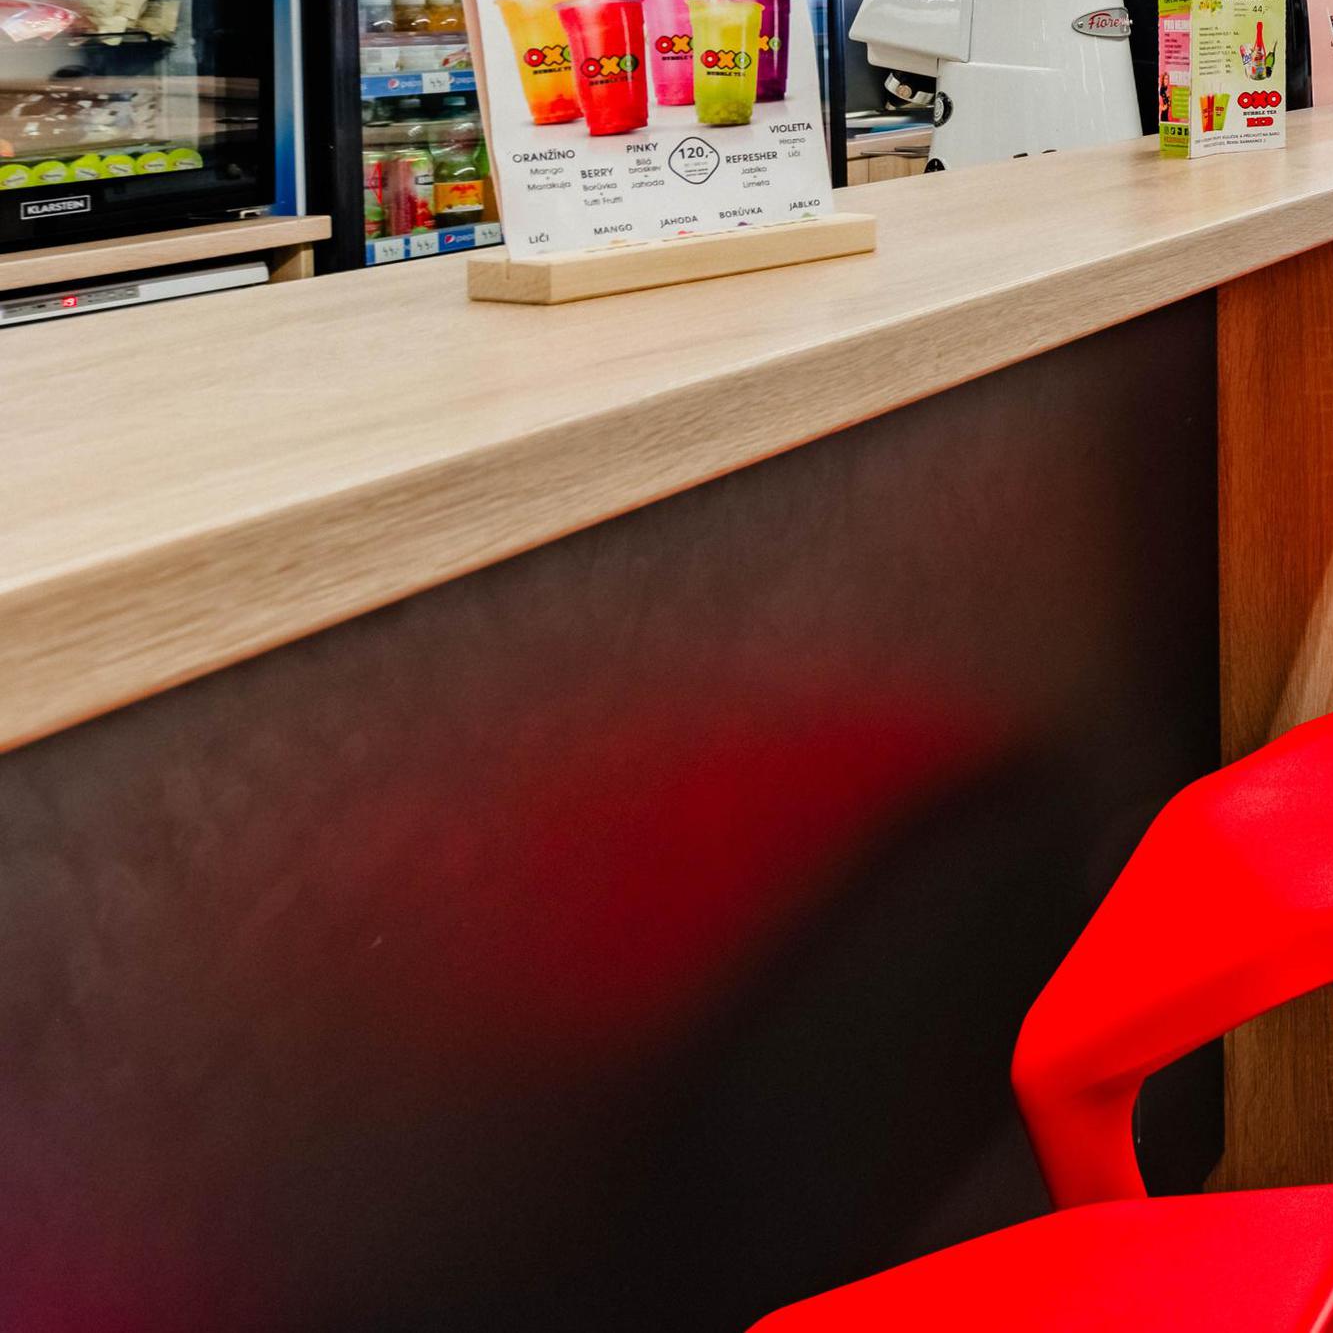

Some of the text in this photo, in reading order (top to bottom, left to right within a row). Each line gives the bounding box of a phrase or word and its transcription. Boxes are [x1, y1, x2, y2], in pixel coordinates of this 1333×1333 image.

[580, 54, 640, 79] OXO
[700, 49, 752, 70] OXO
[1237, 90, 1282, 109] OXO
[769, 122, 813, 134] VIOLETTA
[626, 142, 659, 154] PINKY
[677, 146, 714, 160] 120,-
[512, 149, 576, 164] ORANŽÍNO
[725, 151, 778, 165] REFRESHER
[530, 167, 564, 177] Mango
[580, 167, 614, 179] BERRY
[26, 199, 85, 216] KLARSTEIN
[789, 199, 821, 212] JABLKO
[660, 215, 698, 229] JAHODA
[593, 223, 633, 236] MANGO
[528, 232, 550, 245] LIČI
